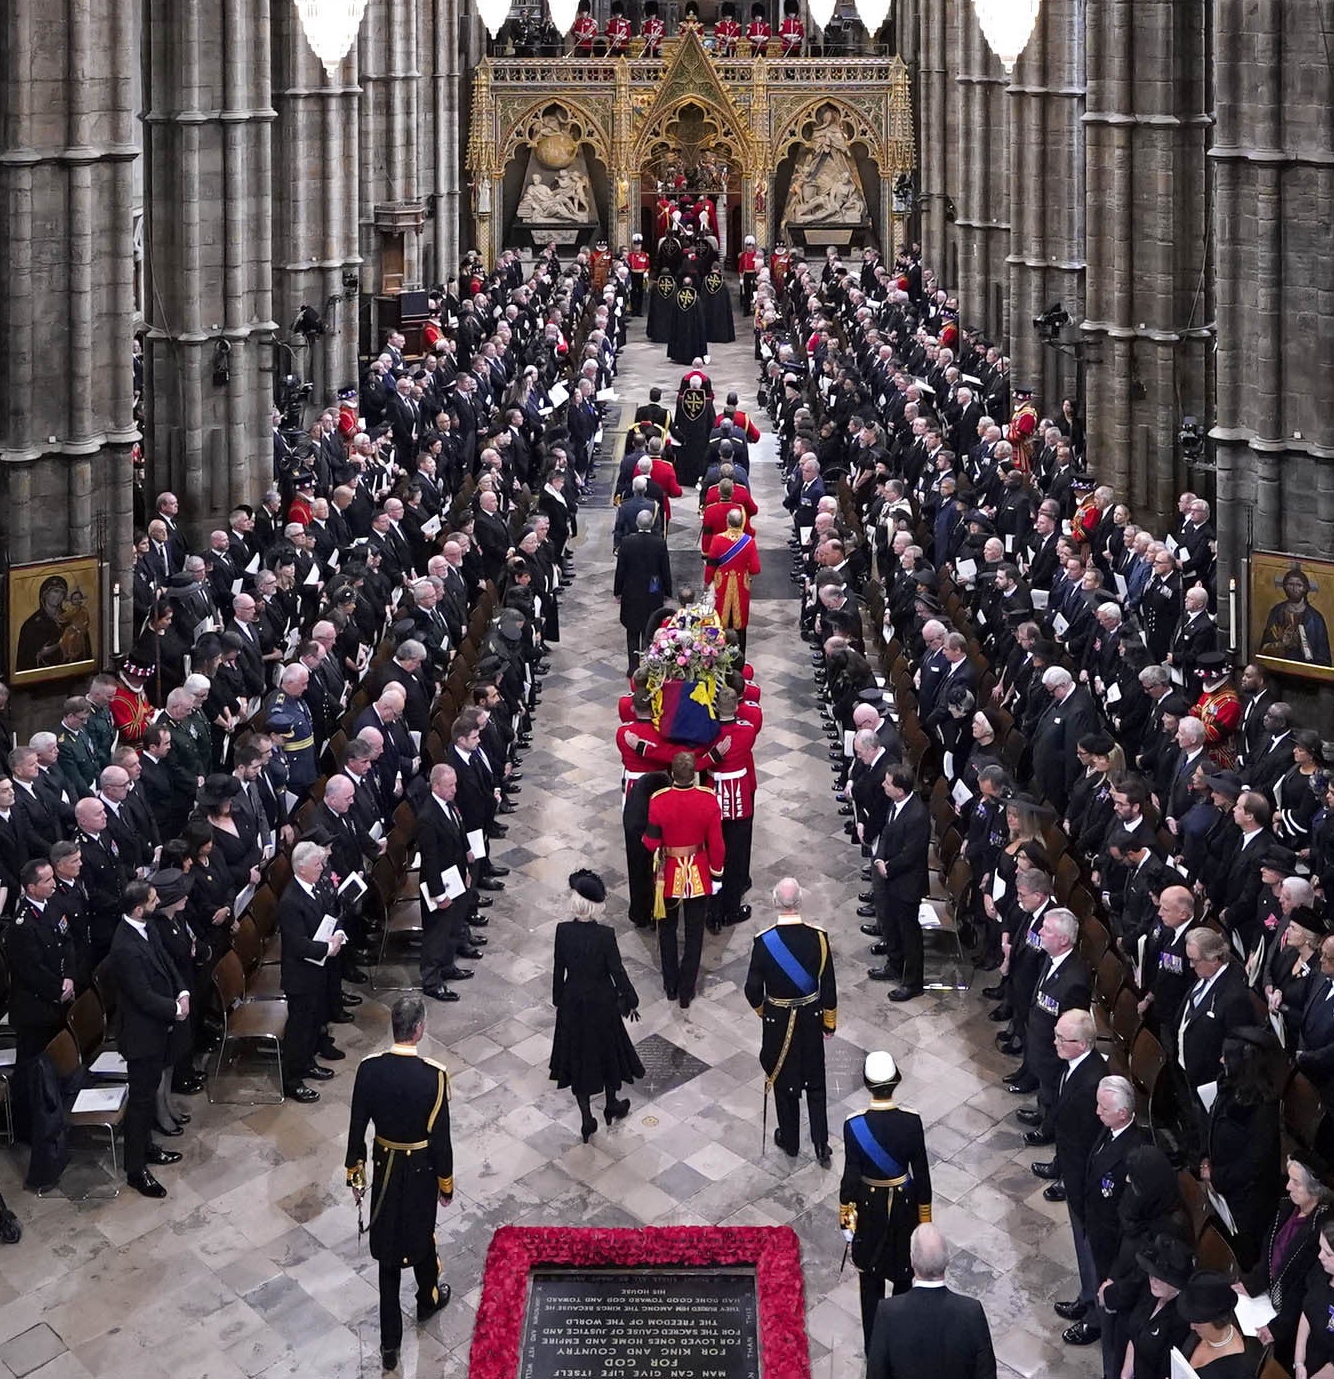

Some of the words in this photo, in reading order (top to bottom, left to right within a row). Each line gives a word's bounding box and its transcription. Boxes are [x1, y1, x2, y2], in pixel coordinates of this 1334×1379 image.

[541, 1337, 580, 1345] EMPIRE
[584, 1337, 608, 1345] AND
[611, 1337, 643, 1345] HOME
[647, 1337, 676, 1346] ONES
[680, 1338, 716, 1346] LOVED
[719, 1337, 741, 1346] FOR
[556, 1347, 617, 1356] COUNTRY
[626, 1347, 652, 1356] AND
[660, 1347, 692, 1356] KING
[701, 1347, 726, 1356] FOR
[603, 1358, 637, 1367] GOD
[650, 1358, 679, 1368] FOR
[553, 1369, 592, 1377] ITSELF
[600, 1369, 625, 1377] LIFE
[633, 1369, 662, 1378] GIVE
[670, 1369, 695, 1378] CAN
[702, 1370, 727, 1378] MAN
